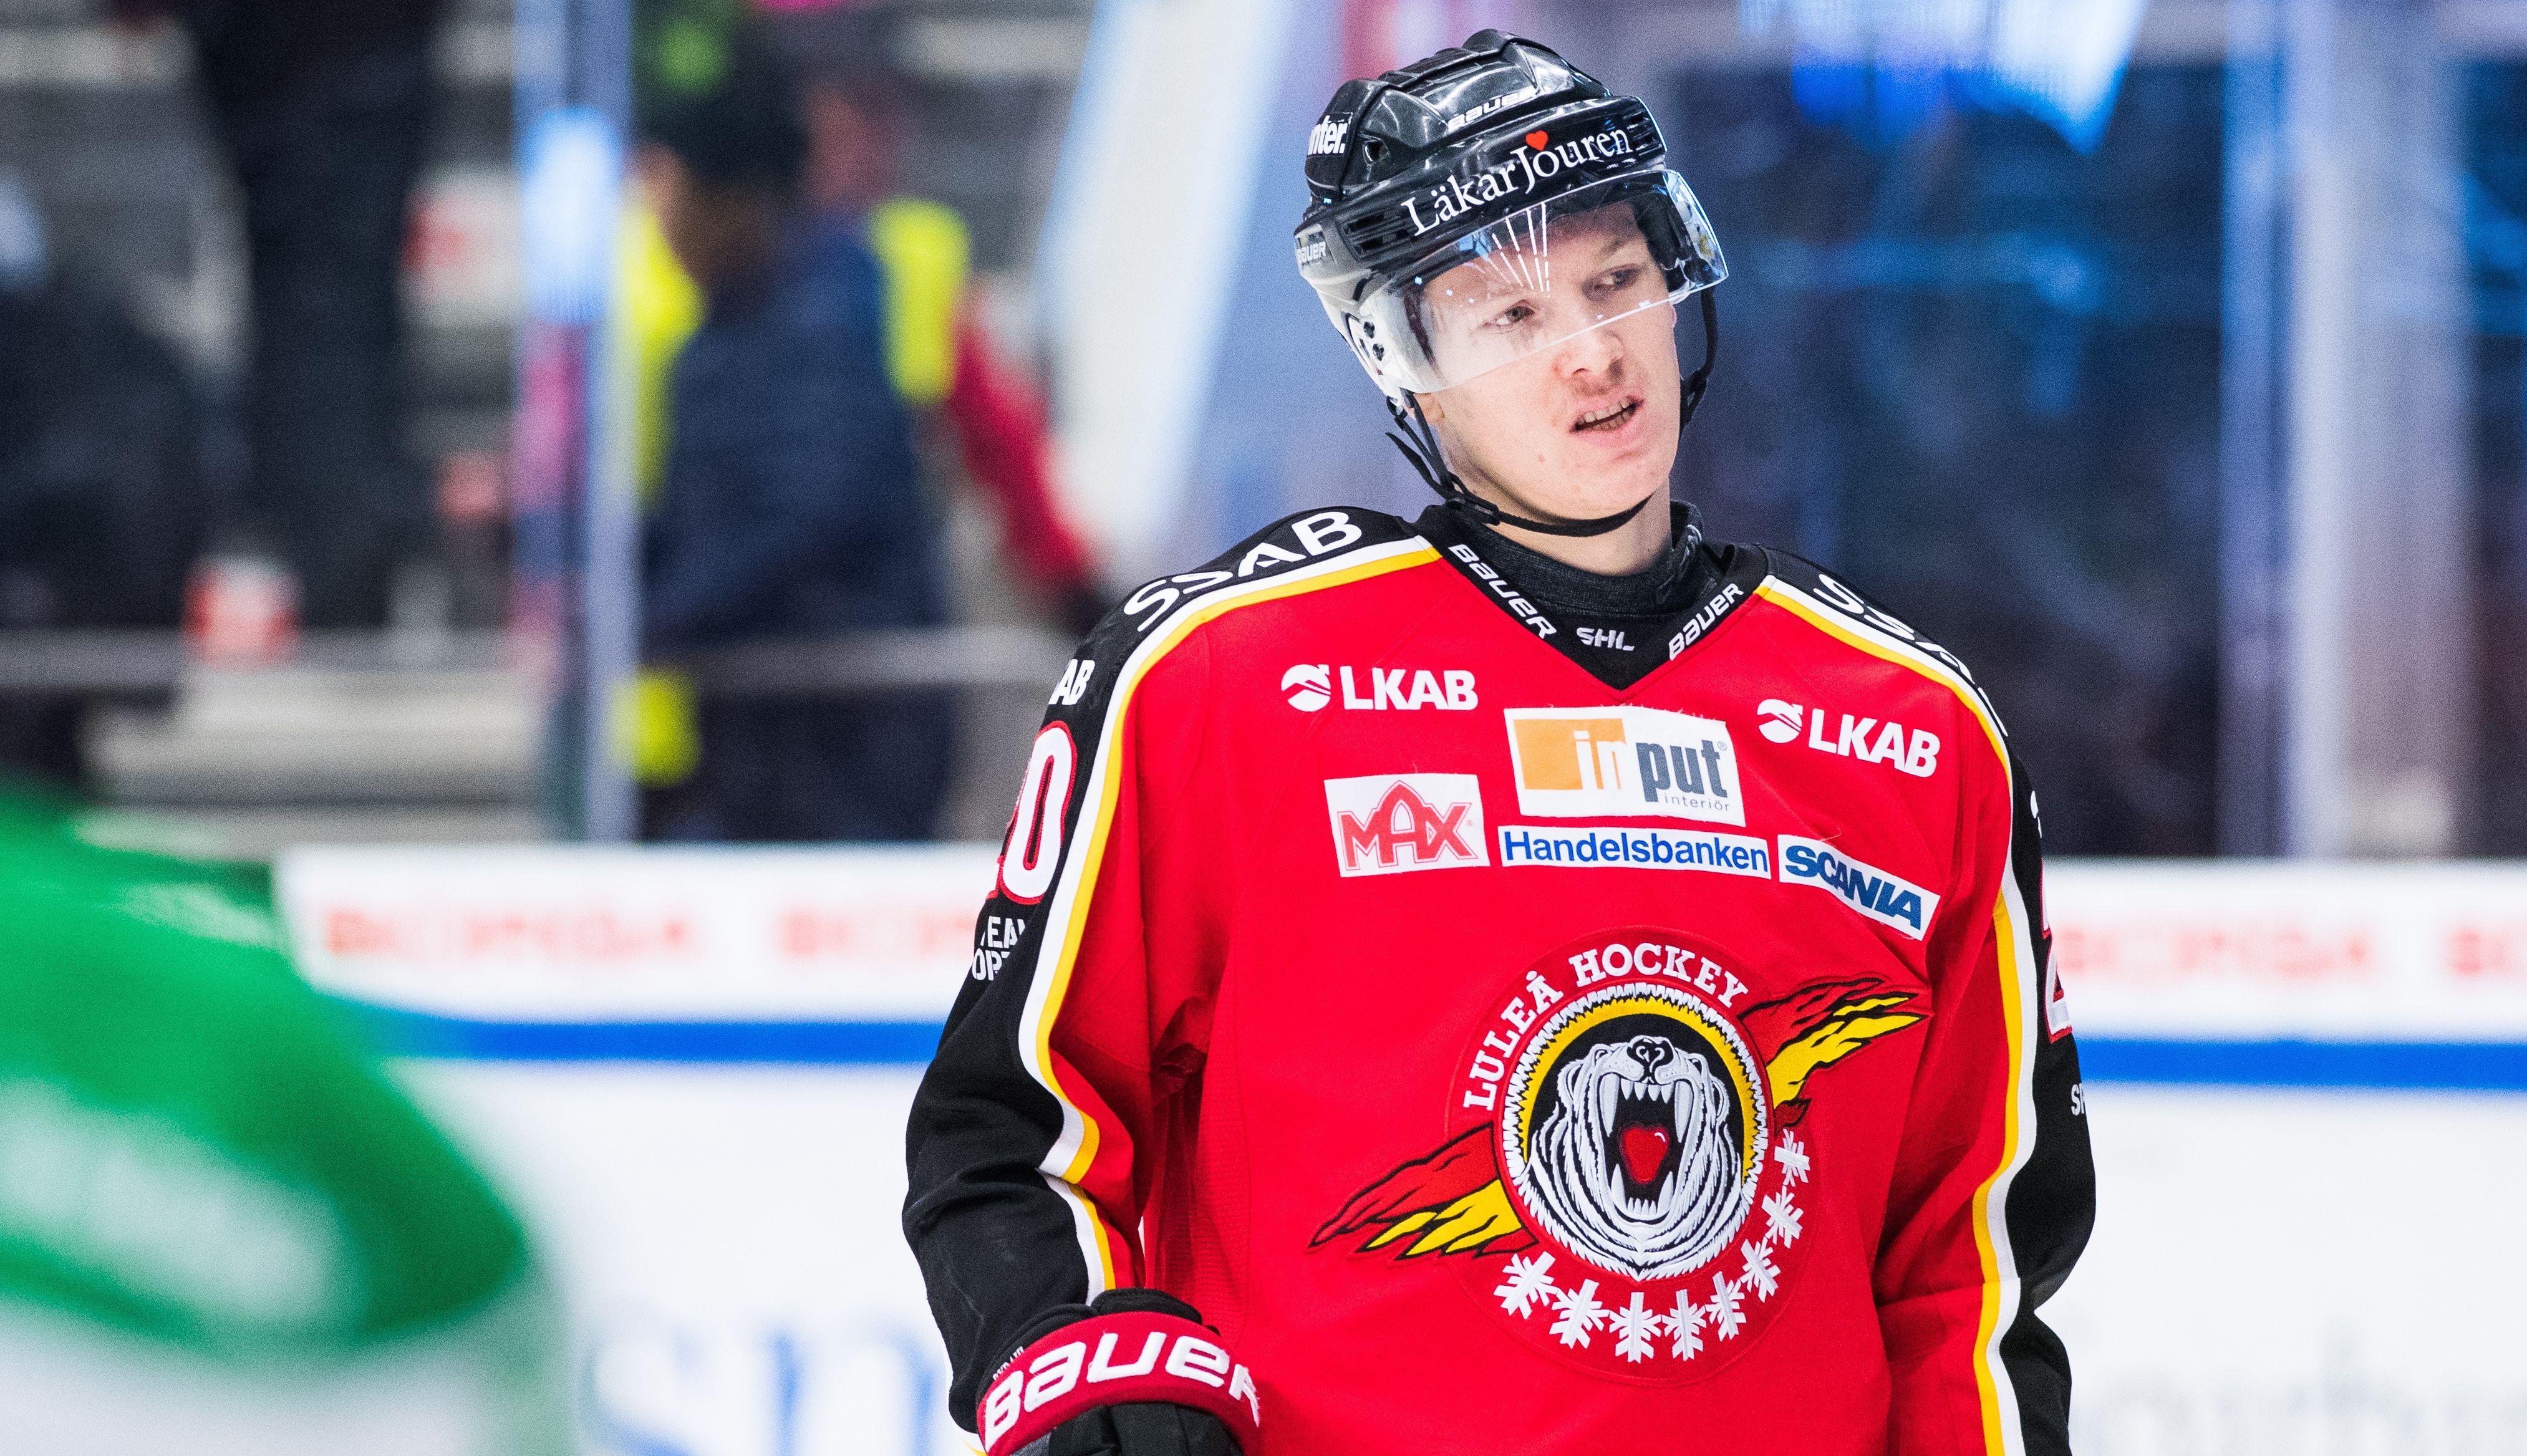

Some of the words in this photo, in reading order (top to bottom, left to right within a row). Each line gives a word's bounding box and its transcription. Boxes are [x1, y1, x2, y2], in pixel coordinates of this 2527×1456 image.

[1401, 129, 1633, 237] LäkarJouren
[1576, 627, 1635, 651] SHL
[1340, 665, 1479, 710] LKAB
[1809, 708, 1941, 778] LKAB
[1336, 780, 1479, 870] MAX
[1663, 795, 1730, 812] interiör
[1504, 831, 1769, 873] Handelsbanken
[1785, 845, 1921, 931] SCANIA
[1463, 970, 1564, 1111] LULEÅ
[1568, 942, 1749, 1008] HOCKEY
